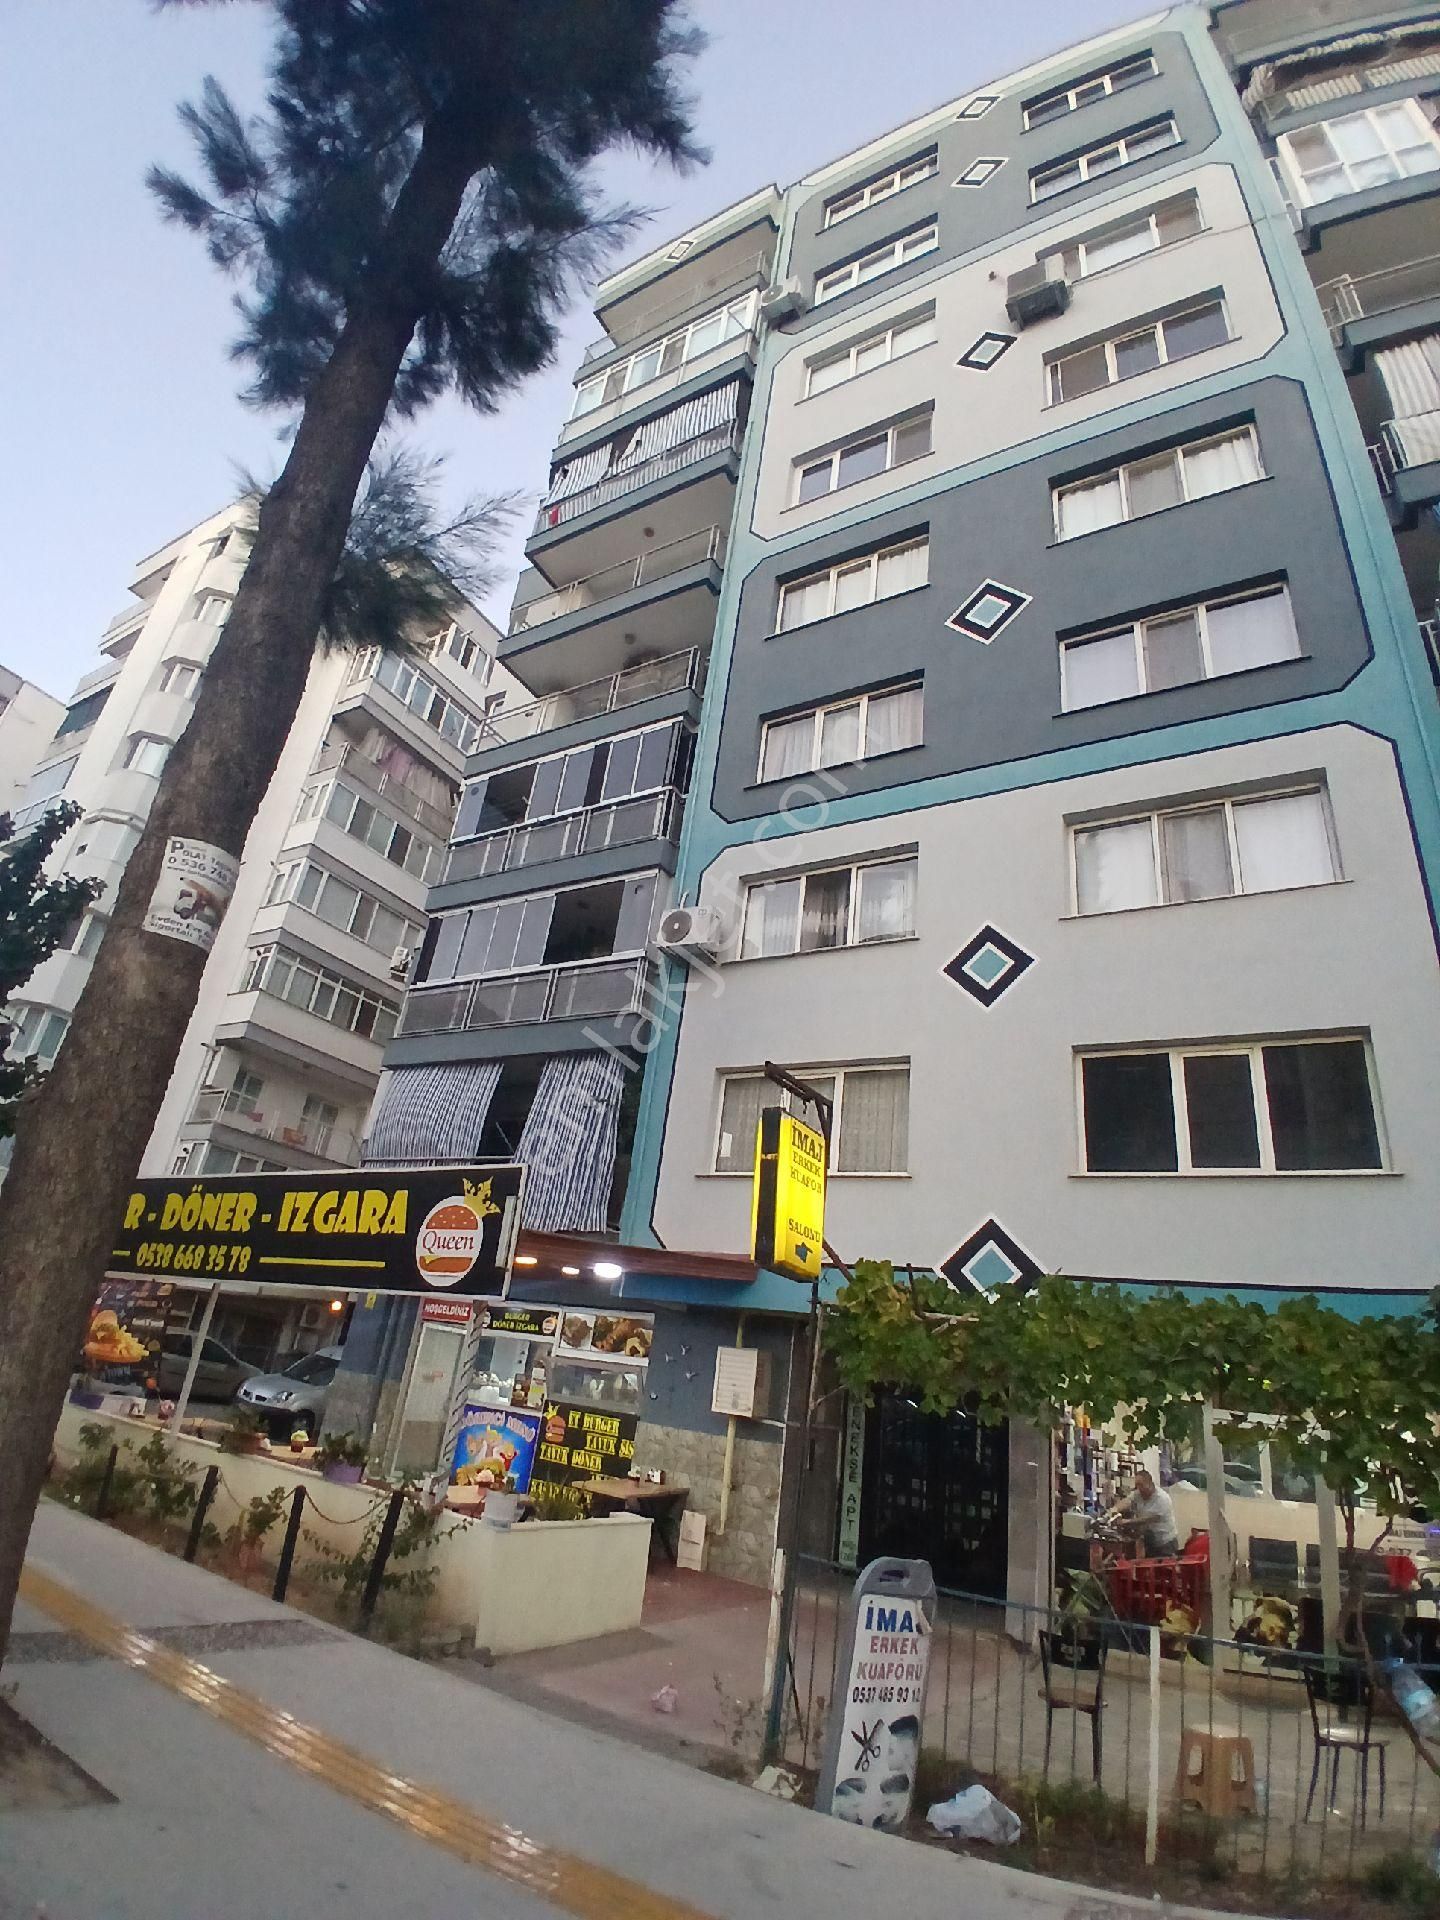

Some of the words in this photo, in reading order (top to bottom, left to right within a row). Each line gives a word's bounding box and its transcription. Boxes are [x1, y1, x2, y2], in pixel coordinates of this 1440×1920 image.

[792, 1150, 822, 1178] ERKEK
[160, 1184, 258, 1233] DÖNER
[277, 1189, 409, 1236] IZGARA
[421, 1229, 475, 1254] Queen
[788, 1217, 821, 1243] SALONU
[136, 1241, 175, 1269] 0538
[174, 1243, 206, 1270] 668
[206, 1244, 228, 1272] 35
[228, 1245, 252, 1273] 78
[582, 1412, 622, 1437] BURGER
[846, 1492, 858, 1531] APT
[869, 1635, 919, 1655] ERKEK
[896, 1686, 910, 1703] 93
